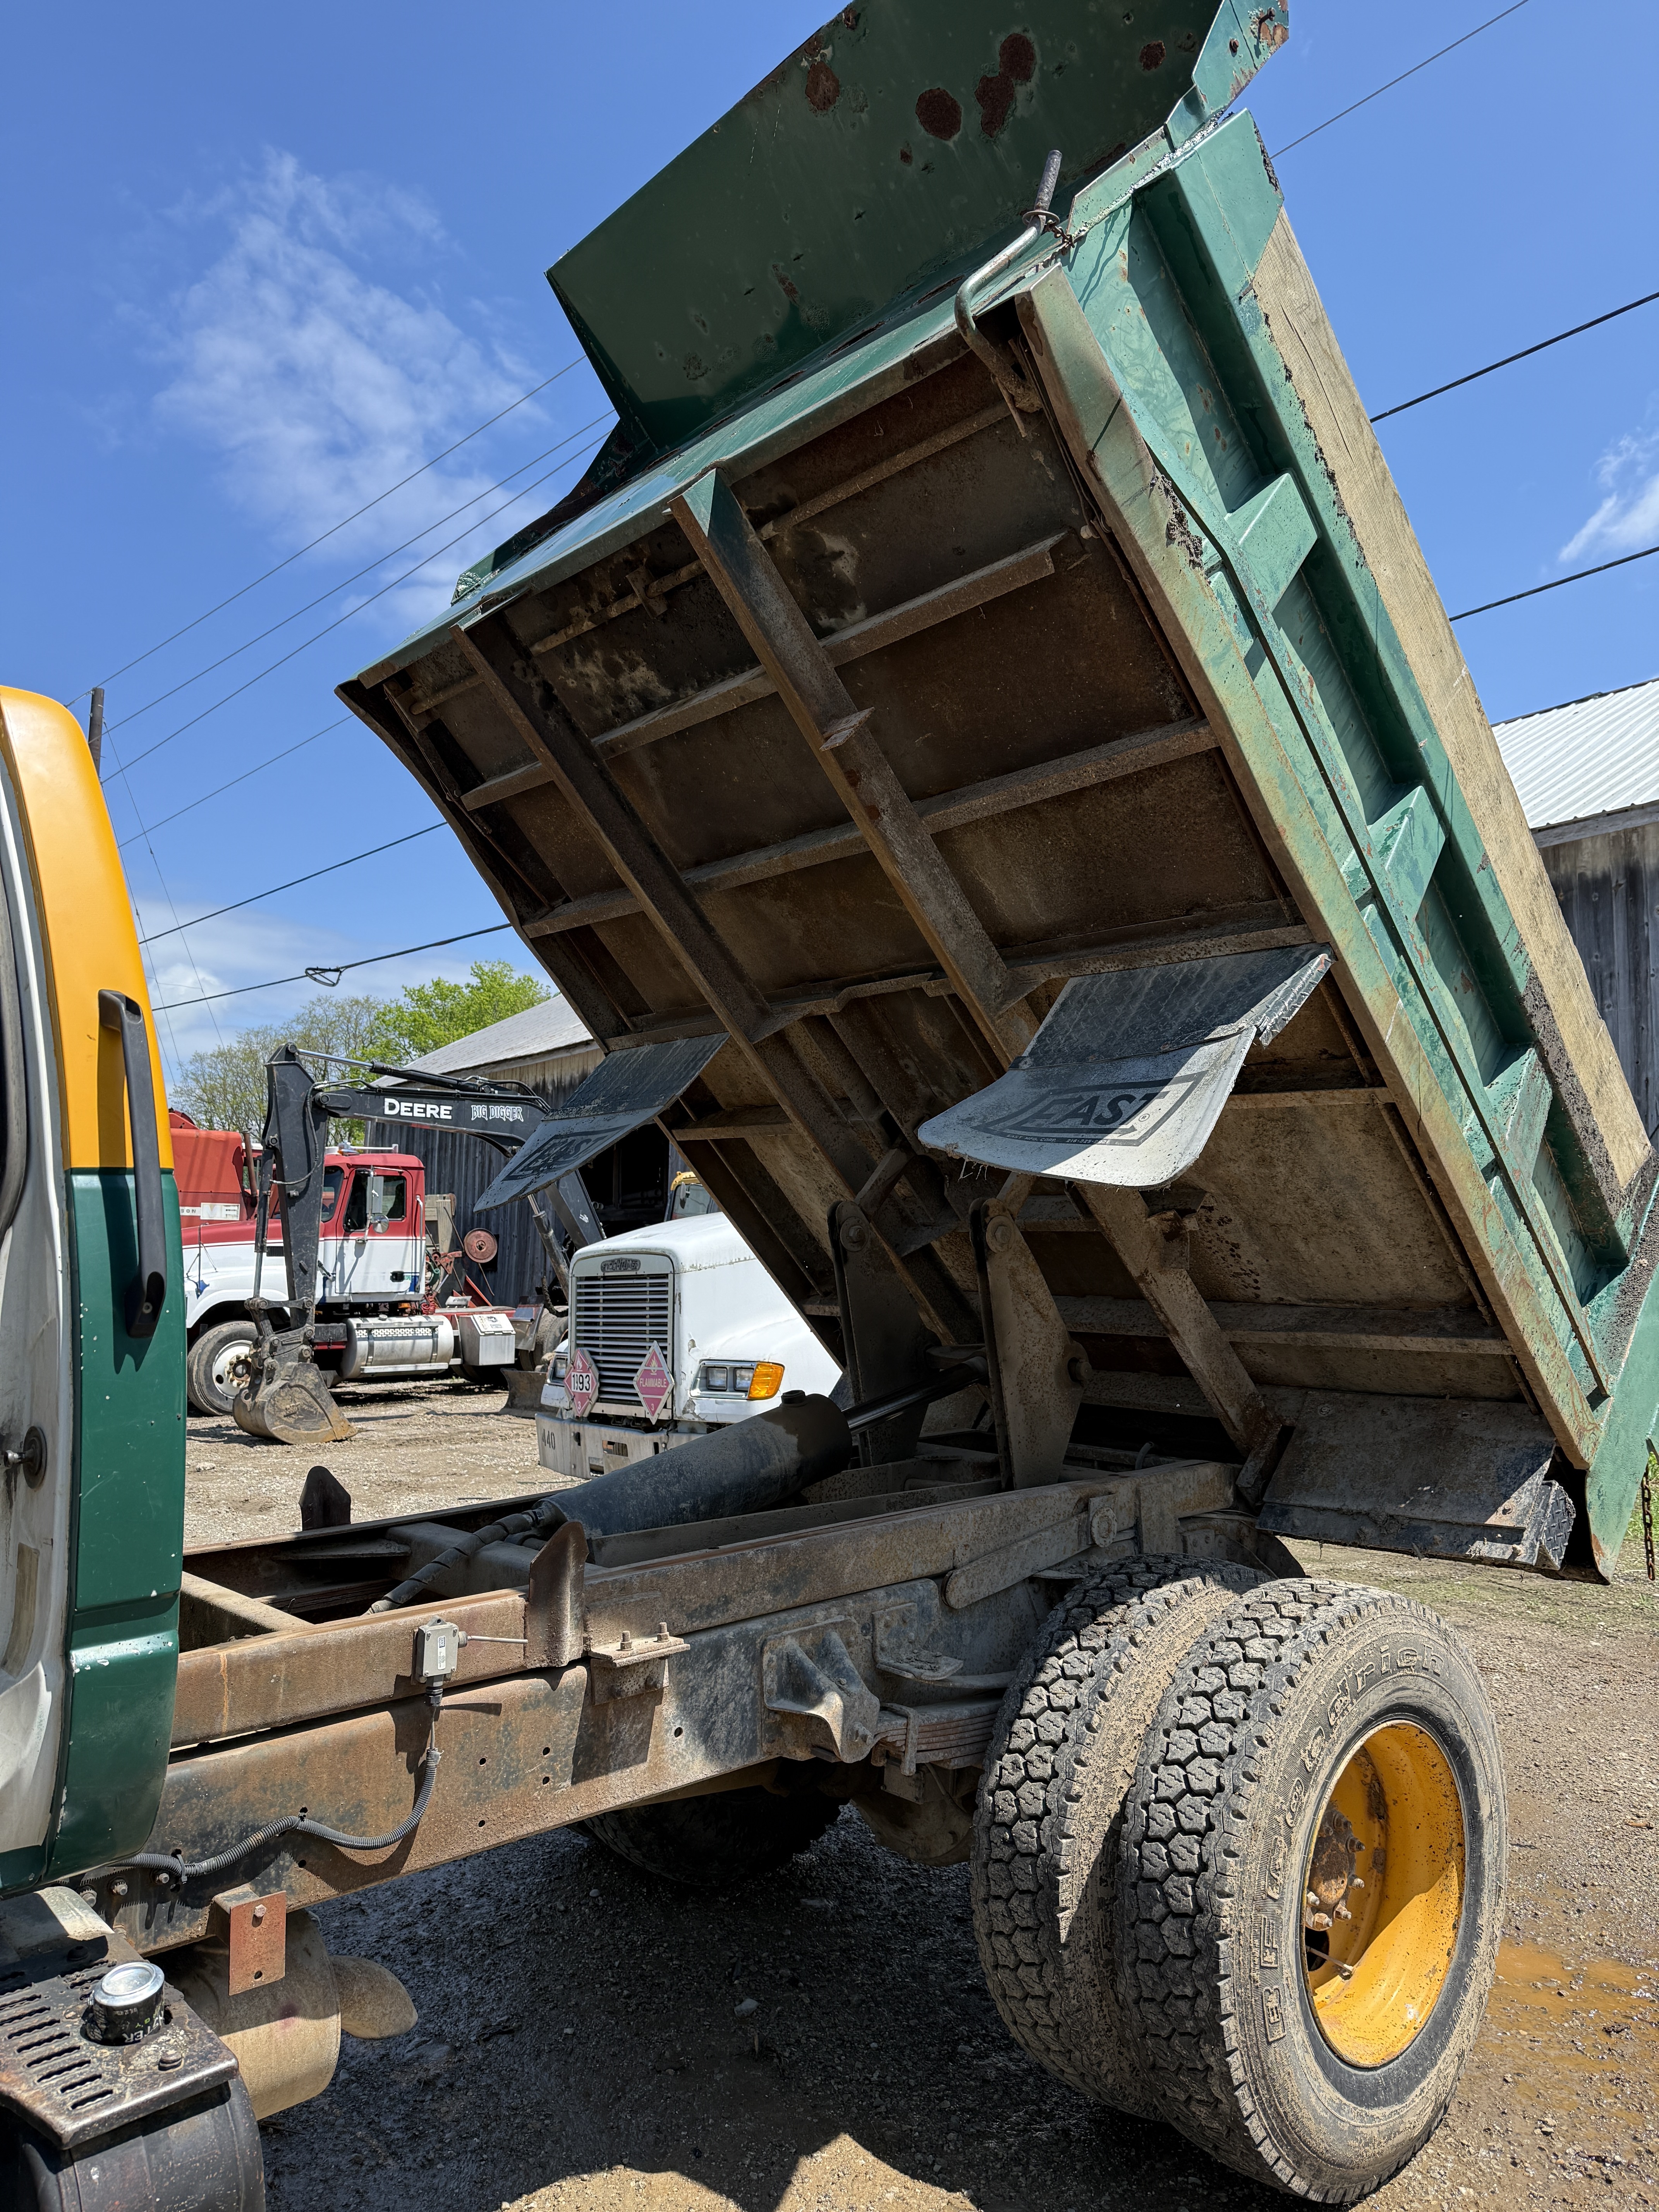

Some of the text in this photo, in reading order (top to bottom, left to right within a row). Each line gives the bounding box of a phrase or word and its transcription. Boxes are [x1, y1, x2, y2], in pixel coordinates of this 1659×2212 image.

[385, 1098, 452, 1119] DEERE
[471, 1105, 524, 1122] BIG DIGGER
[1009, 1091, 1170, 1134] EAST
[572, 1374, 591, 1391] 1993
[640, 1378, 667, 1388] FLAMMABLE
[578, 1401, 581, 1410] 3
[542, 1429, 555, 1450] 440
